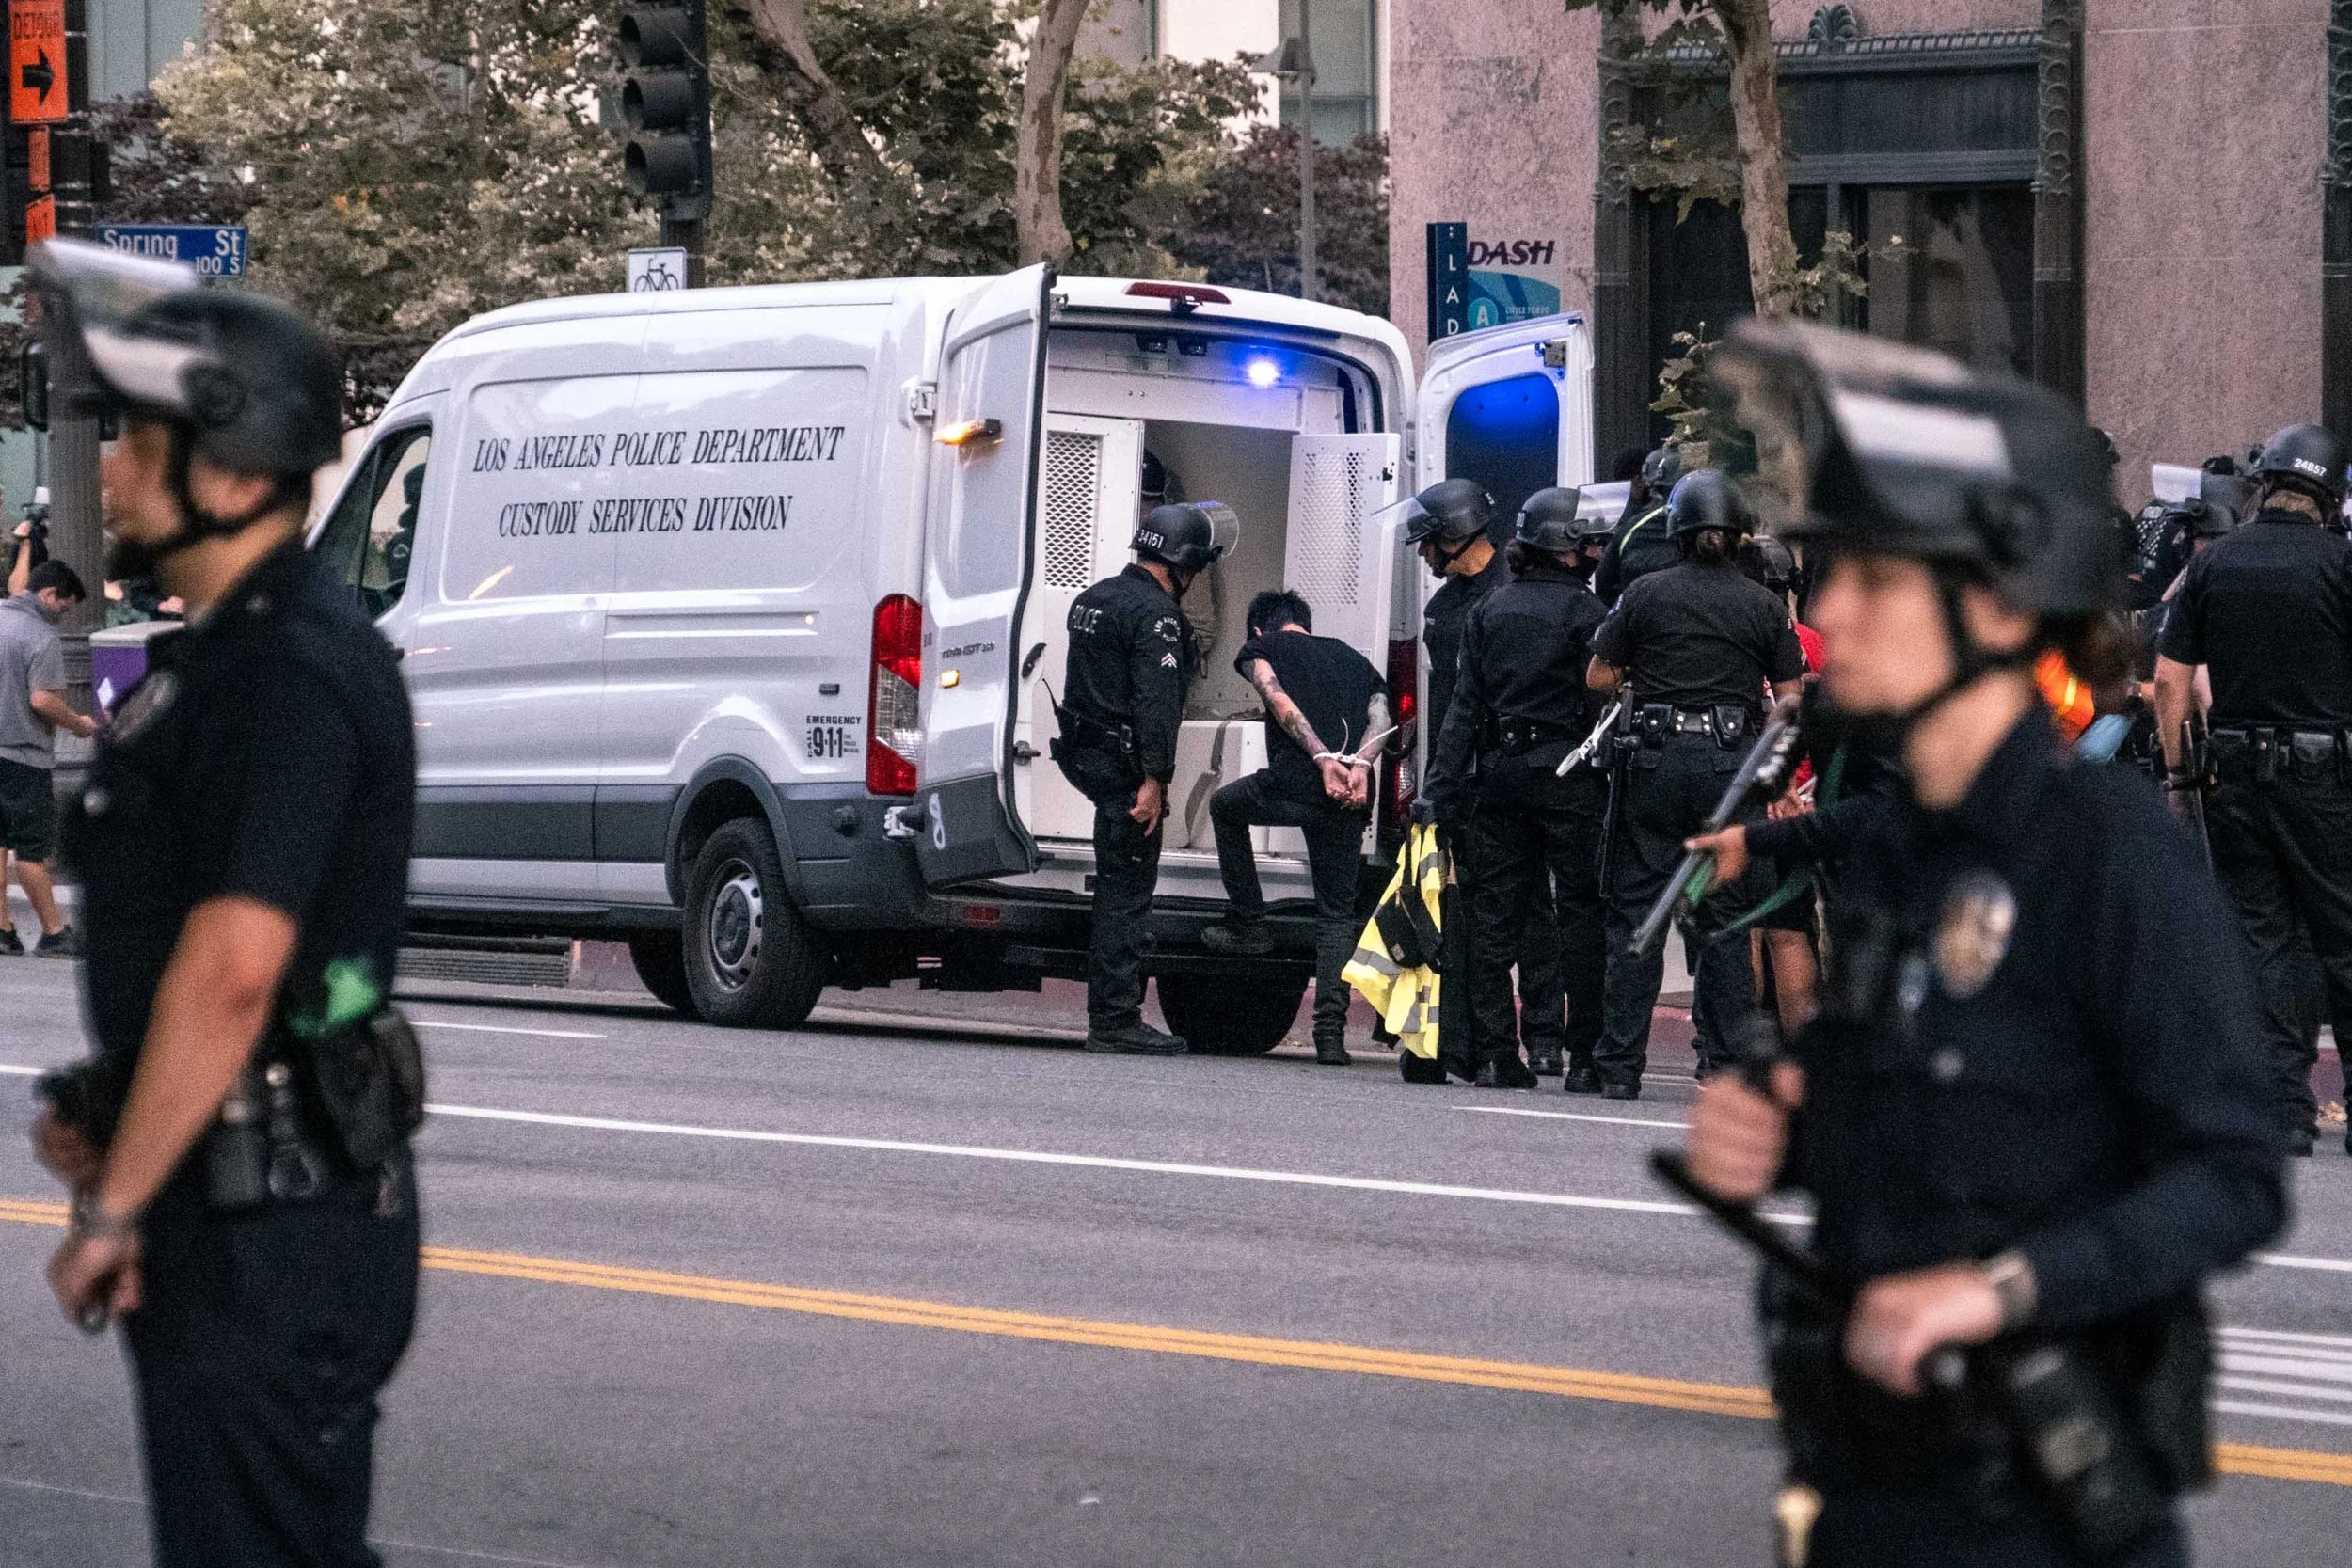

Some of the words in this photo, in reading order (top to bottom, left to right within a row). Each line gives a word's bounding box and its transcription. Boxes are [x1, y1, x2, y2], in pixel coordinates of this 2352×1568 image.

[103, 229, 179, 264] Spring
[215, 230, 241, 256] St
[1467, 239, 1555, 266] DASH
[196, 256, 222, 274] 100
[230, 257, 241, 274] S
[1476, 305, 1490, 326] A
[473, 437, 510, 471] LOS
[514, 433, 605, 469] ANGELES
[610, 431, 687, 467] POLICE
[691, 426, 846, 464] DEPARTMENT
[2294, 458, 2327, 476] 24857
[499, 501, 583, 537] CUSTODY
[588, 498, 687, 534] SERVICES
[693, 495, 793, 531] DIVISION
[1138, 529, 1164, 549] 34151
[806, 715, 861, 725] EMERGENCY
